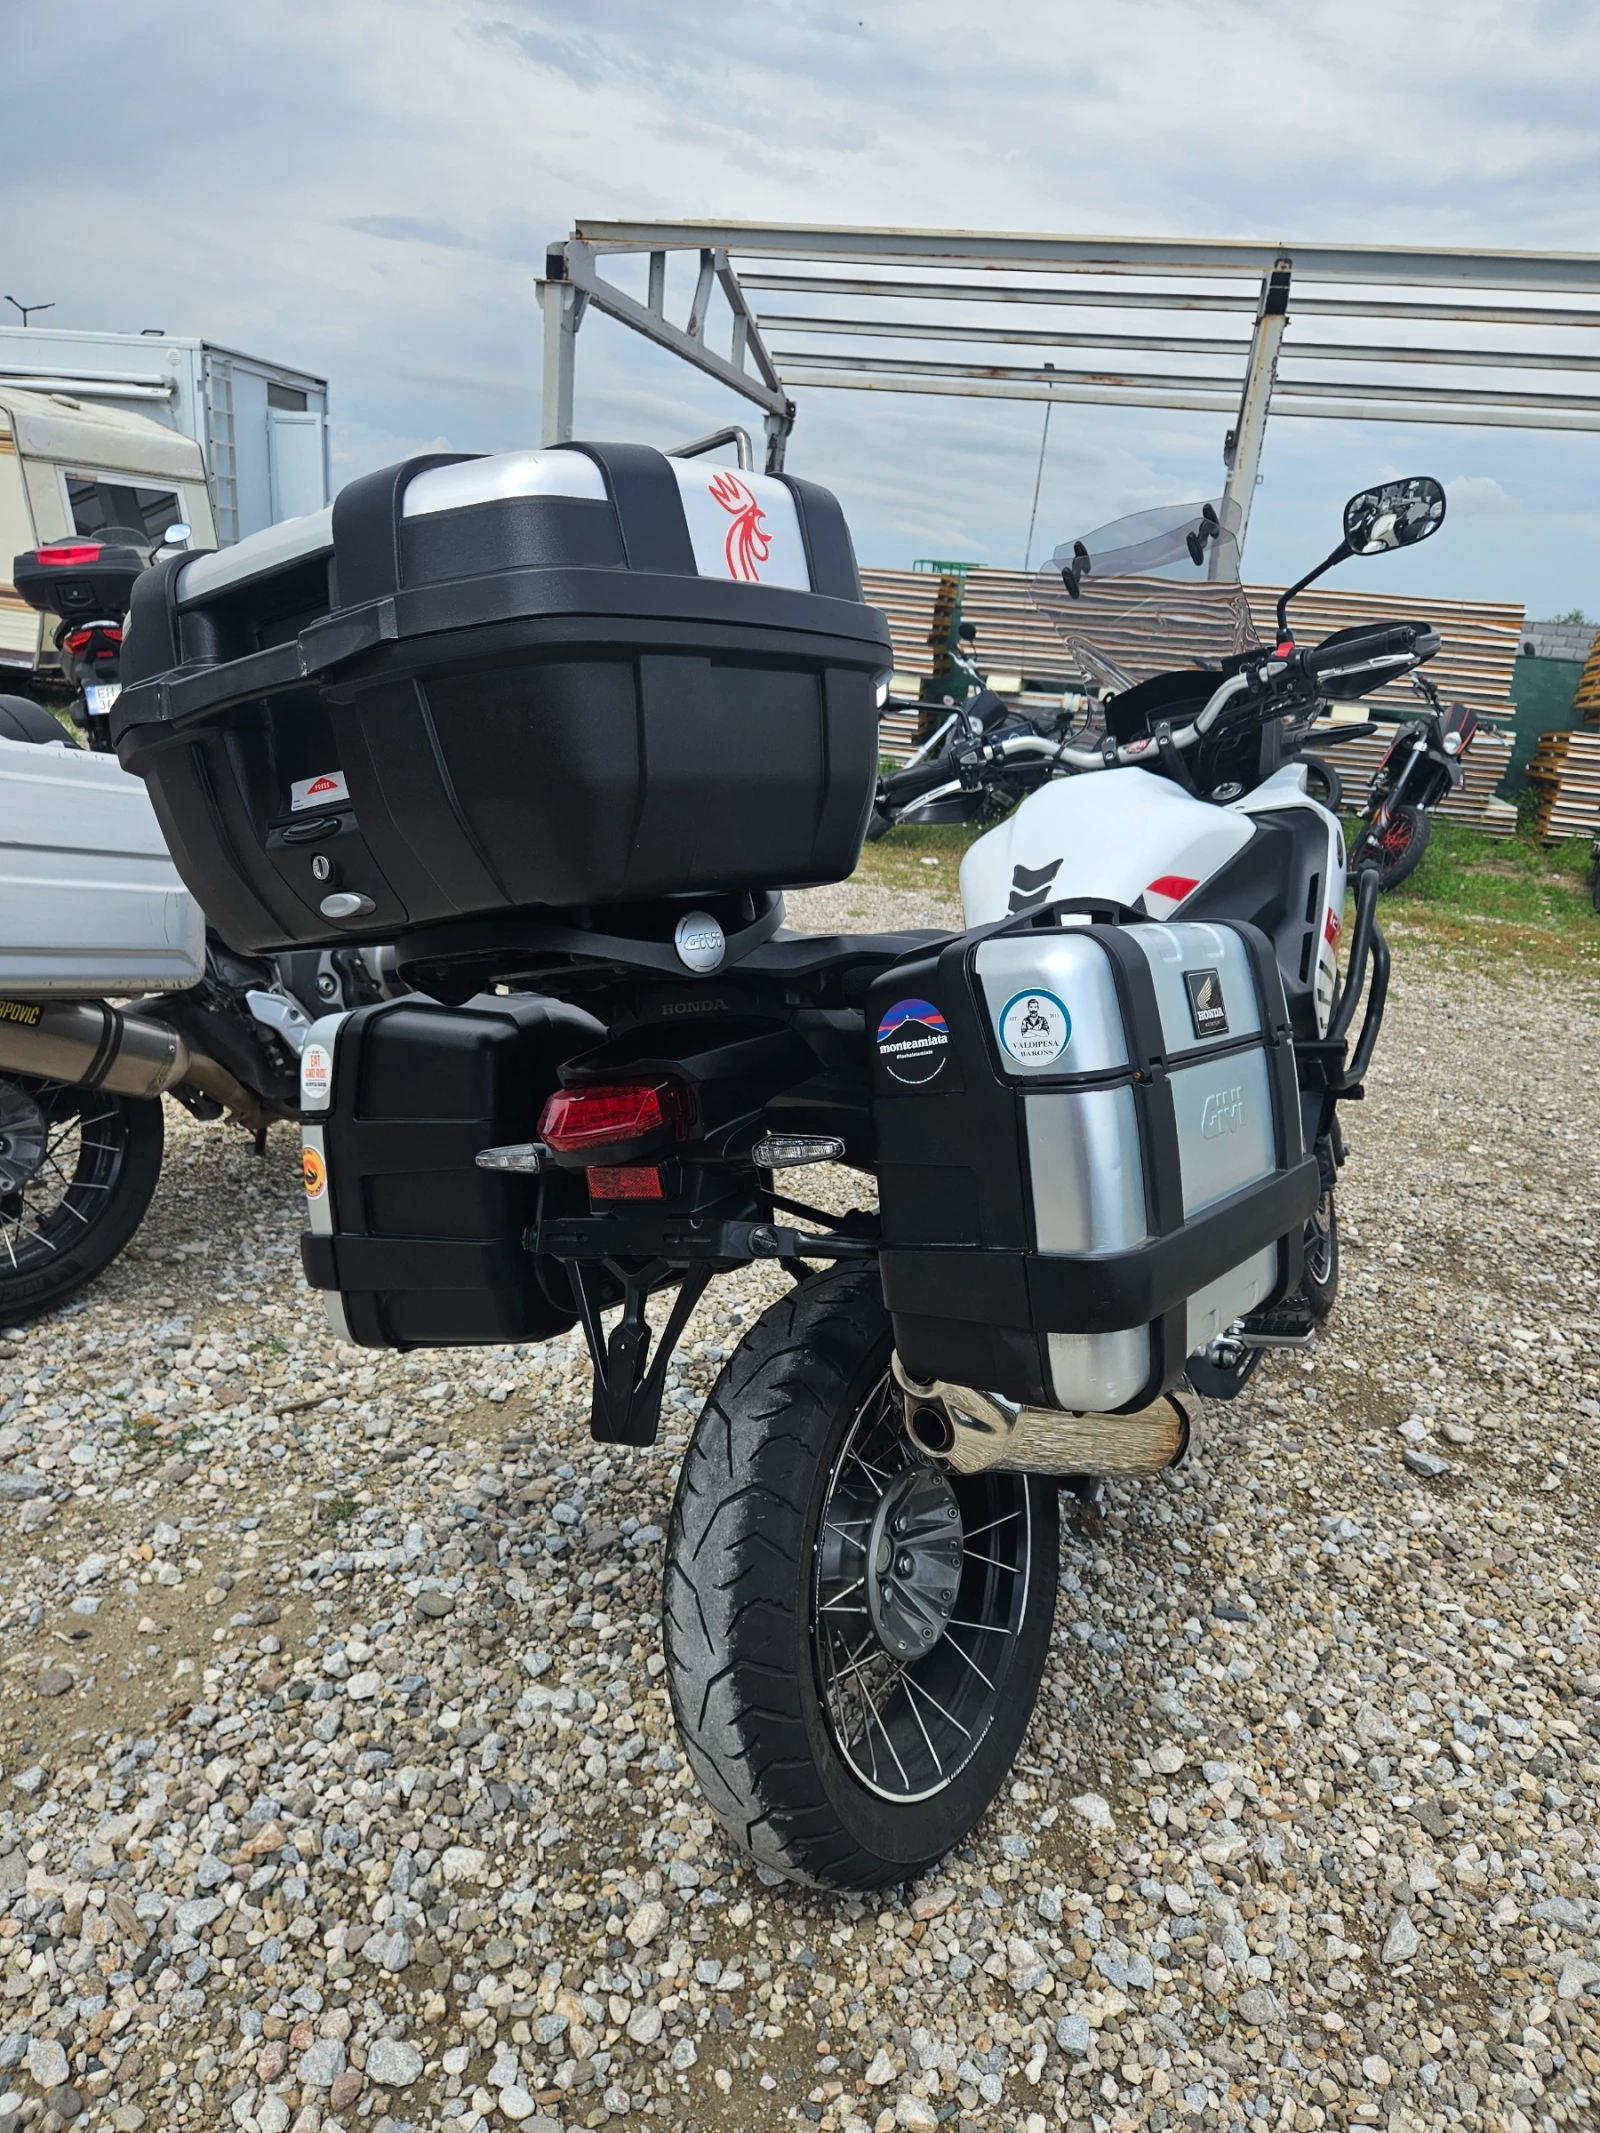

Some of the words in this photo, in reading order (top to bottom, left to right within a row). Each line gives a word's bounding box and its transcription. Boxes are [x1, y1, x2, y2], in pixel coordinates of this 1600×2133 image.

[314, 782, 330, 791] PRESS
[684, 932, 722, 950] GIVI
[661, 1000, 728, 1015] HONDA
[1197, 1007, 1224, 1021] HONDA
[879, 1034, 948, 1054] monteamiata
[1012, 1040, 1059, 1049] VALDIPESA
[310, 1055, 320, 1067] EAT
